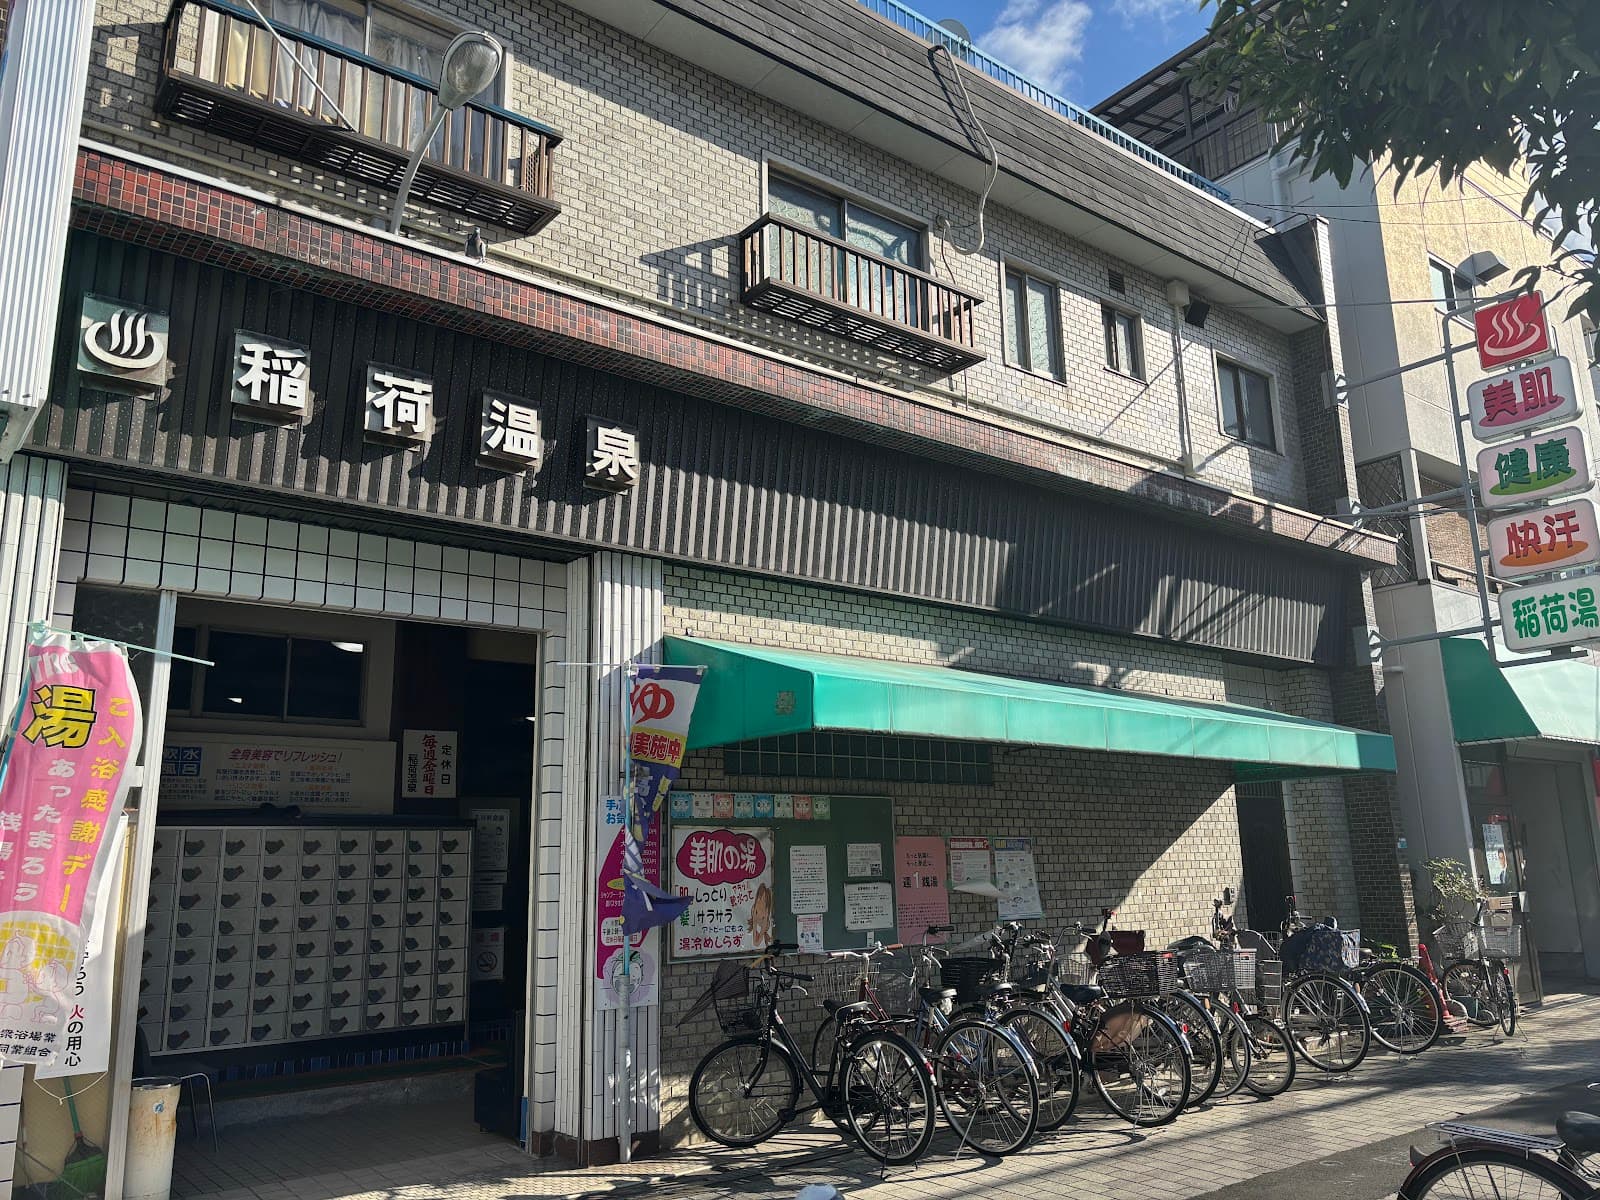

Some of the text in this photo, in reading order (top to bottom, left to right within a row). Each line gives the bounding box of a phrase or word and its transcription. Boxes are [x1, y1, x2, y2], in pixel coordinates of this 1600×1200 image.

[237, 341, 640, 482] 稲荷温泉
[1482, 367, 1559, 421] 美肌
[1494, 437, 1573, 491] 健康
[1507, 509, 1581, 559] 快汗
[1512, 586, 1600, 640] 稲荷湯
[22, 685, 97, 749] 湯
[630, 683, 676, 725] ゆ
[421, 734, 438, 795] 毎週金曜日
[441, 744, 452, 785] 定休日
[630, 731, 682, 764] 実施中
[0, 811, 23, 880] 銭湯
[14, 759, 76, 902] あったまろう
[689, 836, 757, 876] 美肌の湯
[679, 933, 744, 952] 湯冷めしらず
[65, 1003, 85, 1067] 火の用心
